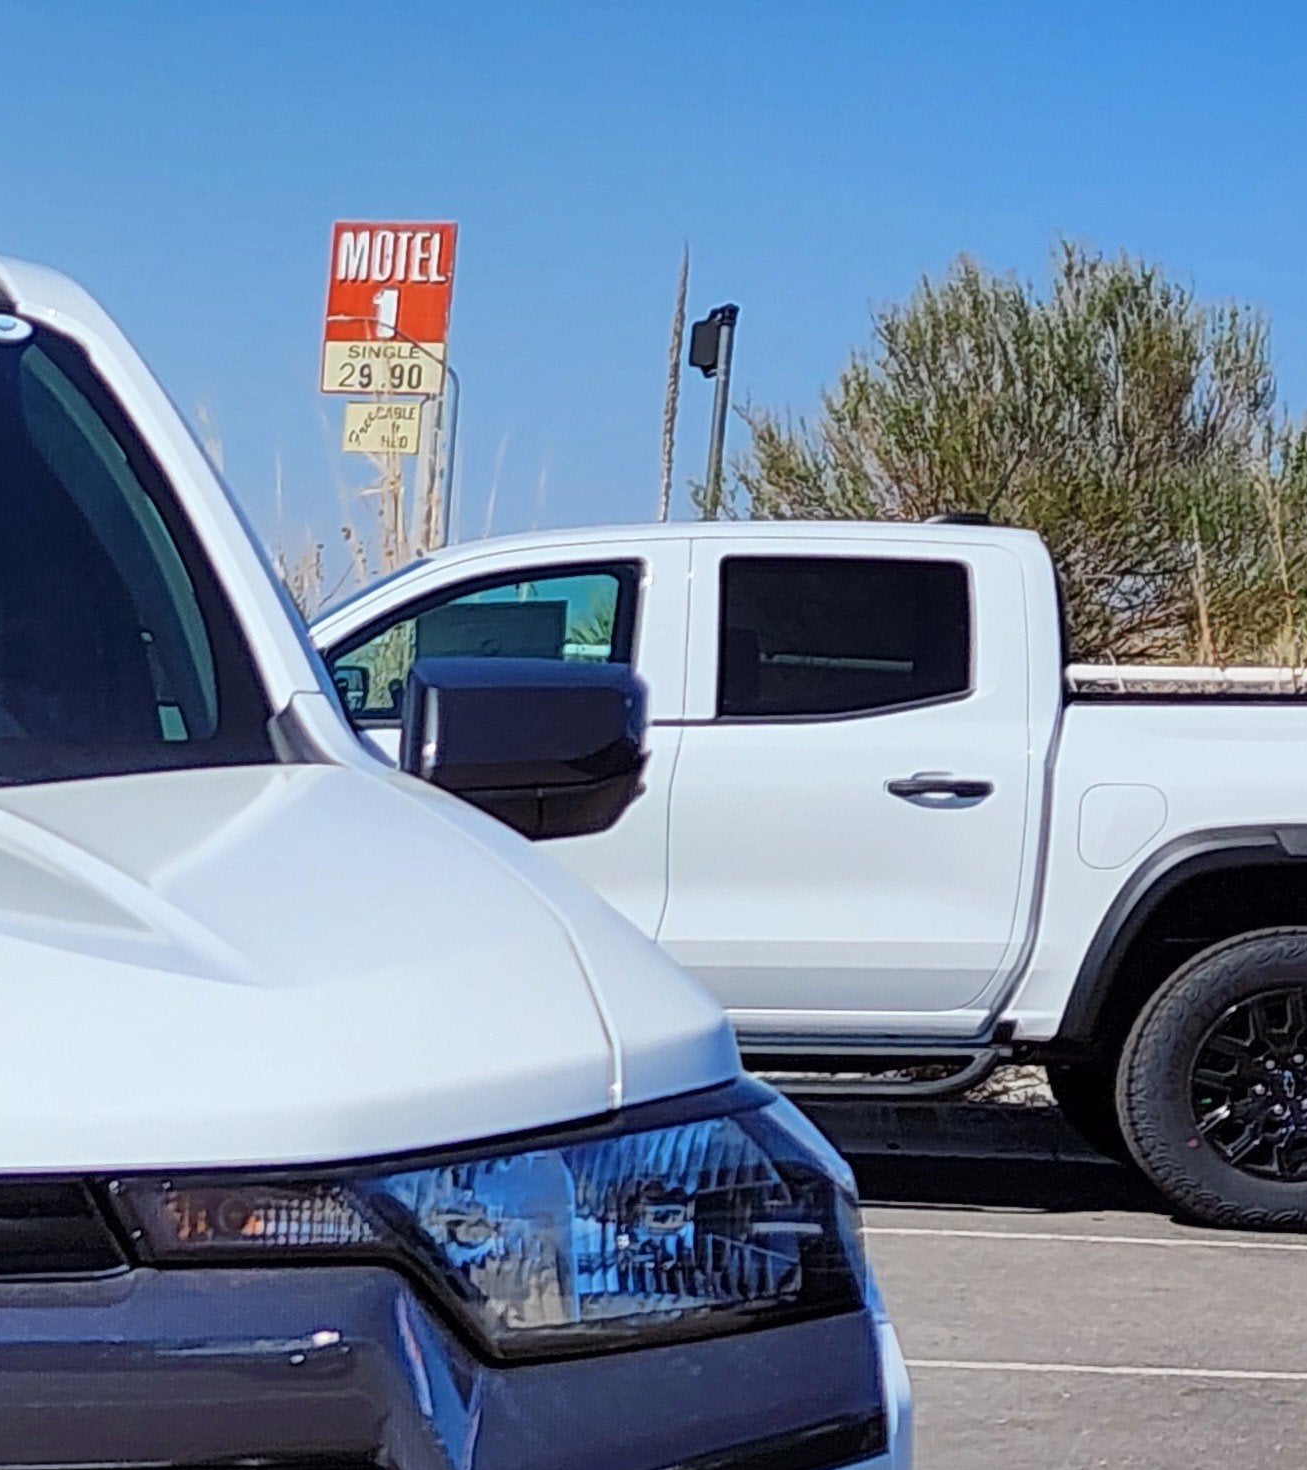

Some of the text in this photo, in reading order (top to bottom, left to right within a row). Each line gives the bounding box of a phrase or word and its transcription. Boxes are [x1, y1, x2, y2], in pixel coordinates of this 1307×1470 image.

[337, 230, 446, 282] MOTEL
[373, 288, 398, 338] 1
[347, 345, 421, 359] SINGLE
